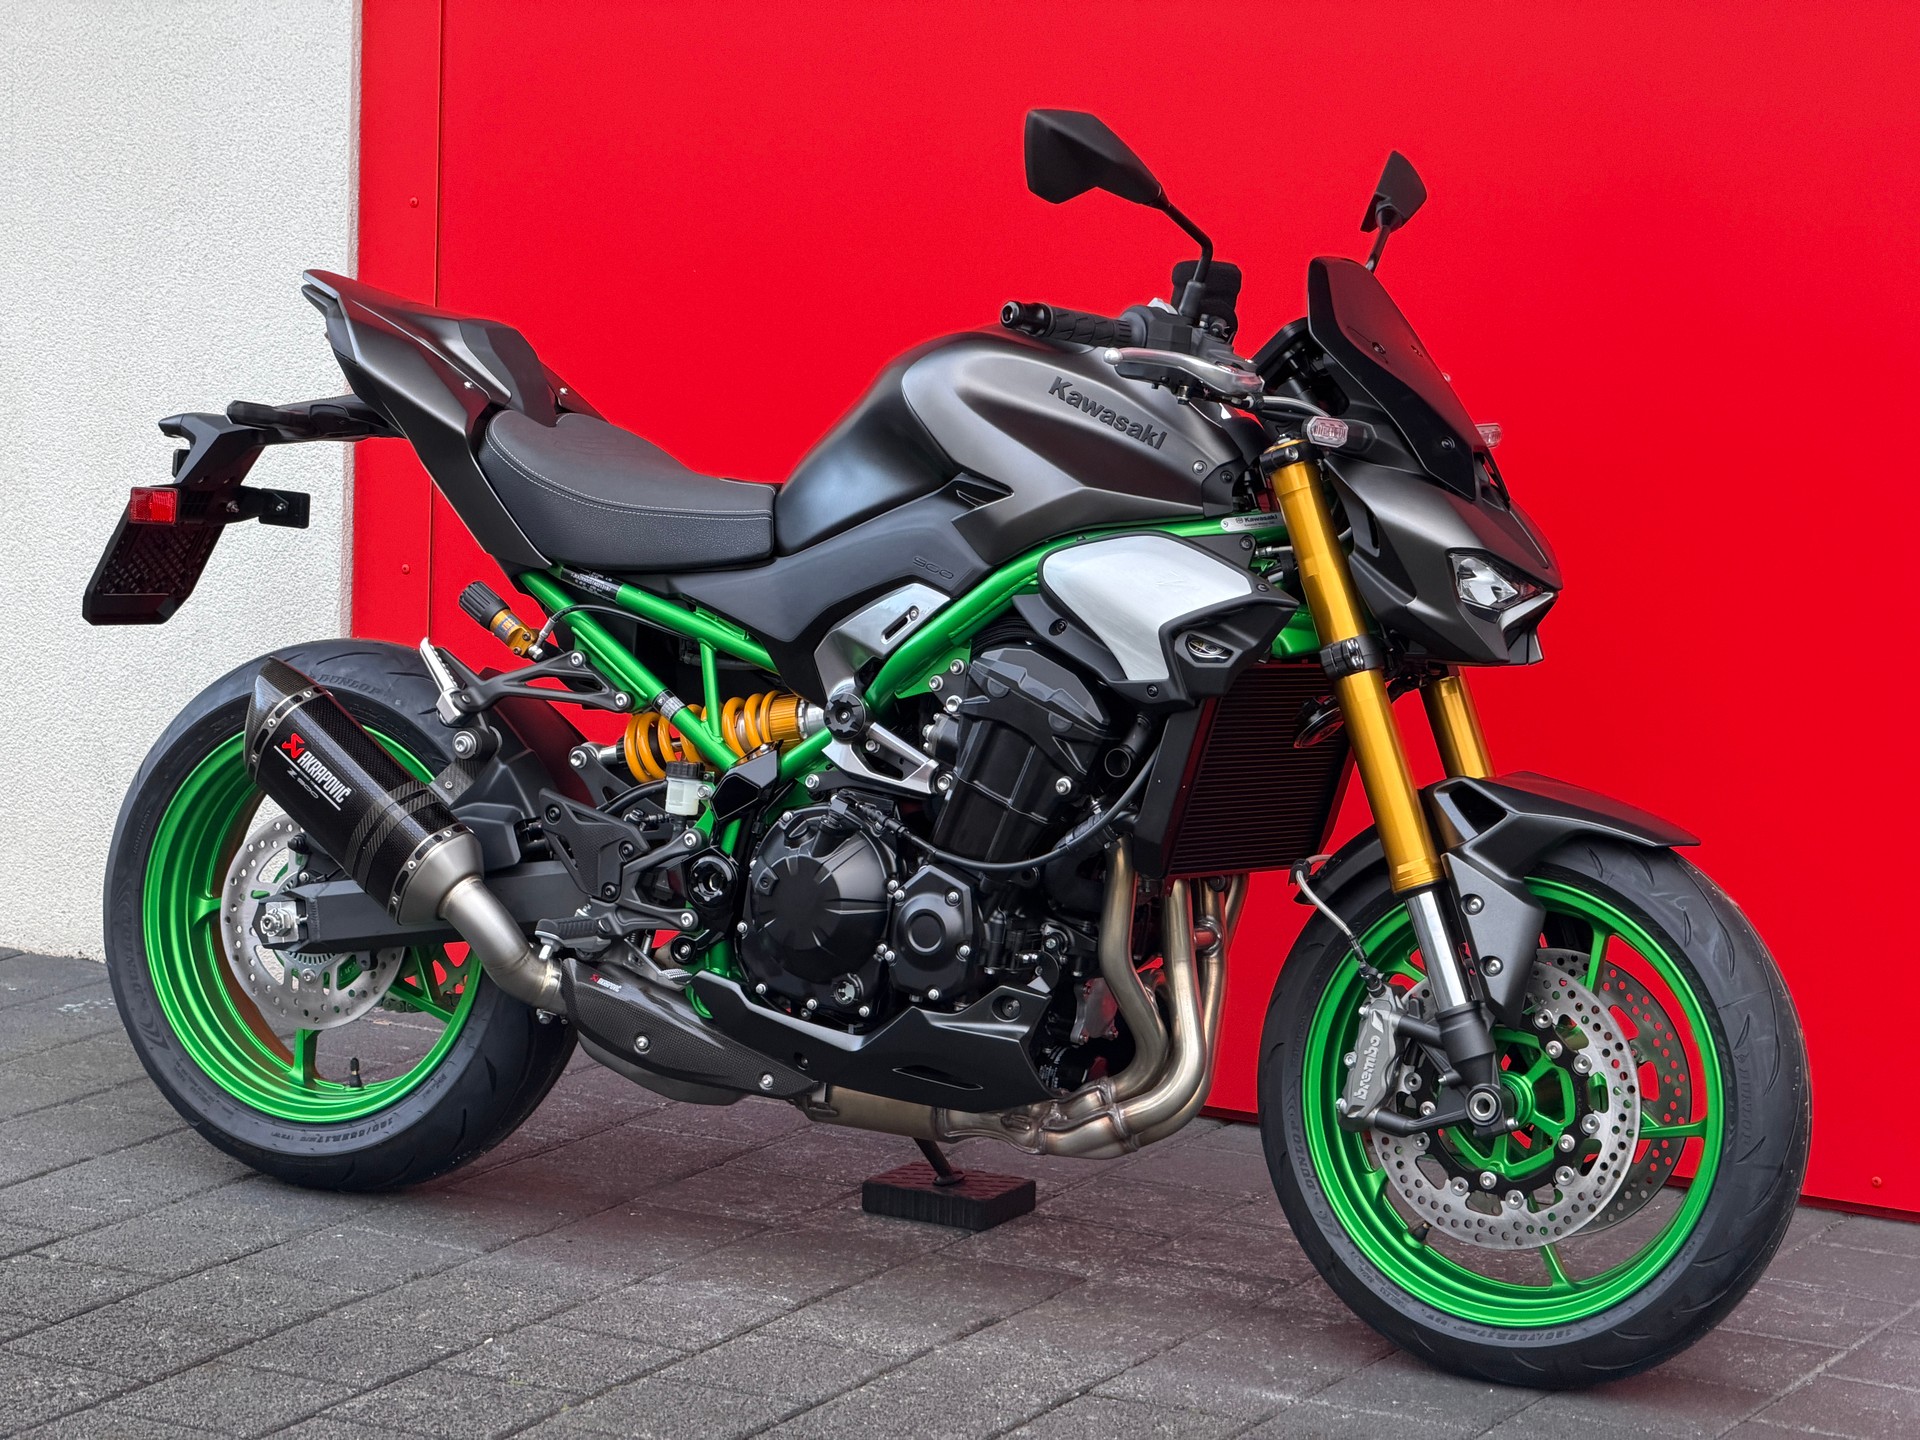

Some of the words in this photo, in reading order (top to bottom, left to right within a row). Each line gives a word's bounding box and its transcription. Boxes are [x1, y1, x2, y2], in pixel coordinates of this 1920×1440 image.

[1048, 376, 1168, 450] Kawasaki
[1244, 514, 1278, 523] Kawasaki
[912, 556, 954, 580] 900
[317, 673, 383, 696] DUNLOP
[1354, 1035, 1381, 1100] brembo
